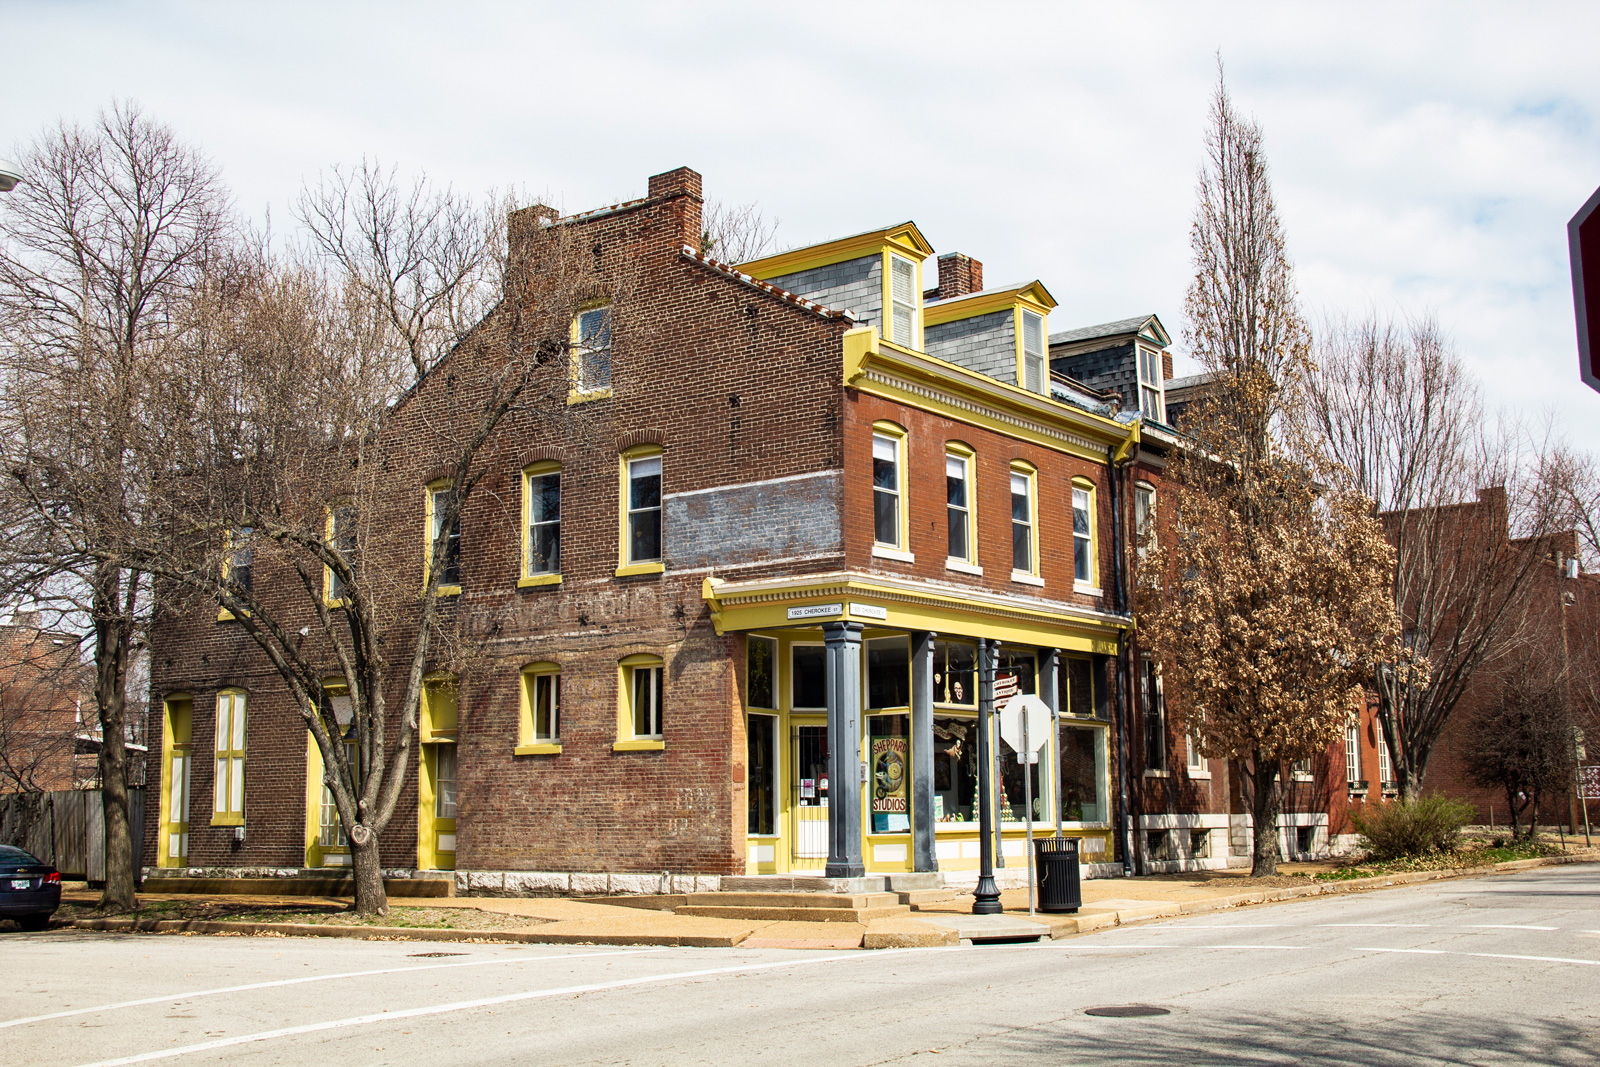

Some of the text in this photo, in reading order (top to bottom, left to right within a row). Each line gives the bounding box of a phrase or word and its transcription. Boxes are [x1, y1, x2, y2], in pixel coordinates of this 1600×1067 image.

[804, 607, 831, 615] CHEROKEE
[872, 738, 908, 755] SHEPPARD
[873, 798, 906, 811] STUDIOS
